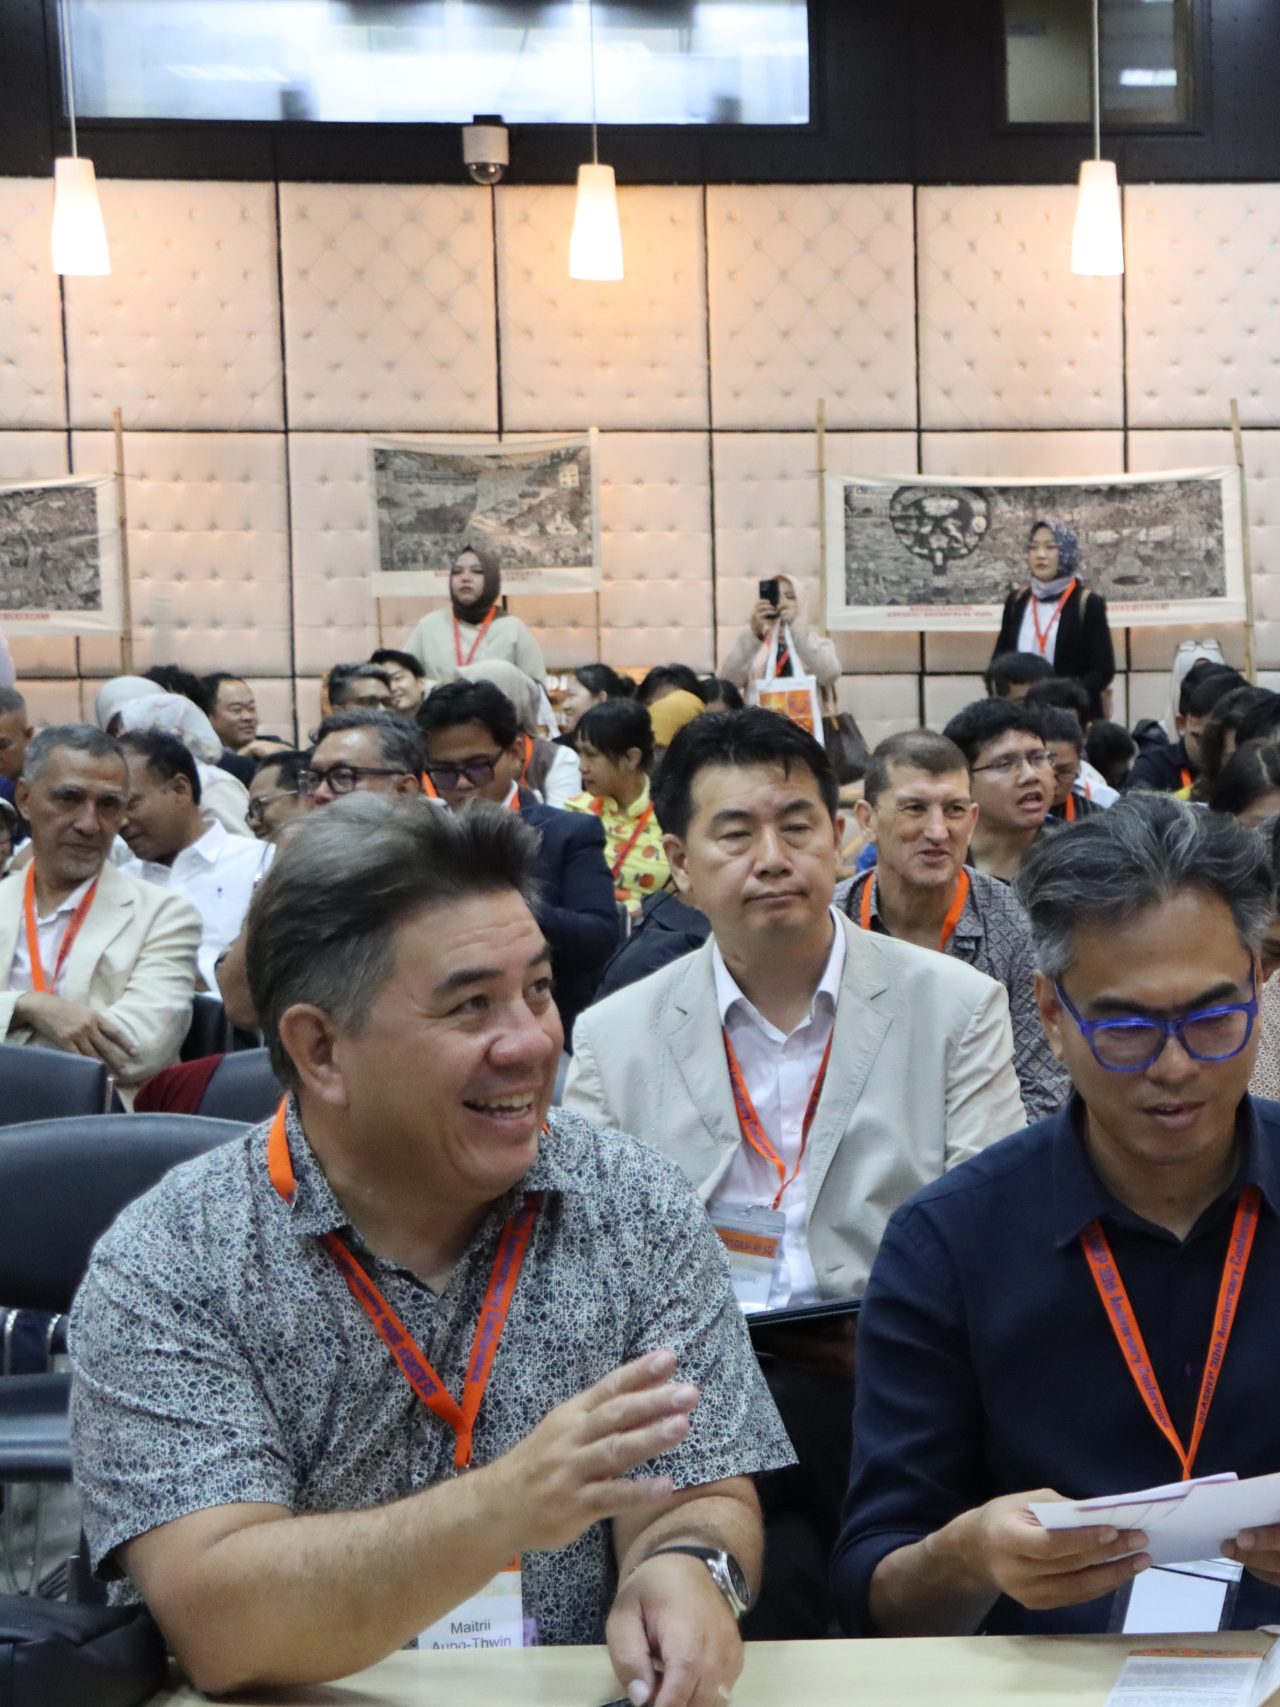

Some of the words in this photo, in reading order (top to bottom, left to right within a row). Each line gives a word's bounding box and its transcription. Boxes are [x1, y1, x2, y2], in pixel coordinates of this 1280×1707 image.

[1229, 1206, 1253, 1266] Conference
[1216, 1269, 1240, 1338] Anniversary
[397, 1346, 438, 1399] SEASREP
[471, 1311, 502, 1382] Conference
[1098, 1266, 1119, 1293] 30th
[1109, 1295, 1142, 1364] Anniversary
[1137, 1365, 1171, 1428] Conference
[1211, 1342, 1223, 1369] 30th
[1197, 1370, 1216, 1425] SEASREP
[450, 1619, 491, 1634] Maitrii
